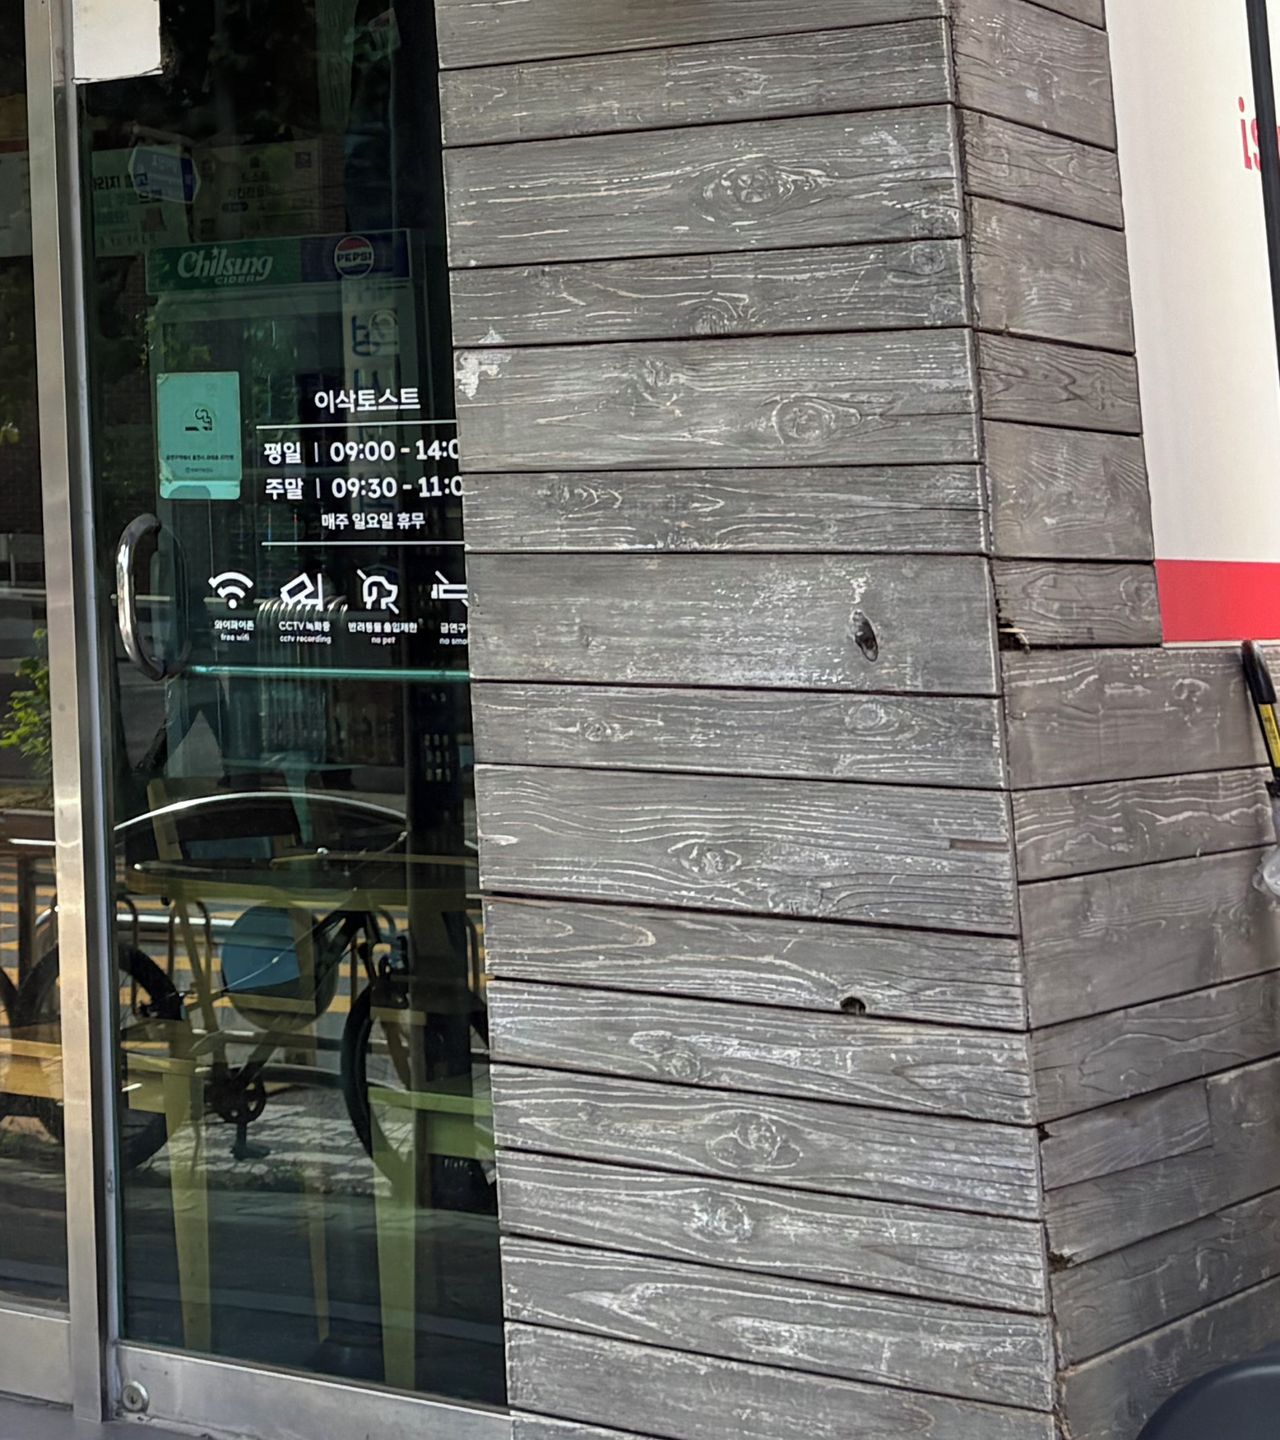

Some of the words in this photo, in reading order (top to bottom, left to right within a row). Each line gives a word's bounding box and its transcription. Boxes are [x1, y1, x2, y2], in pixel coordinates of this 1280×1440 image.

[177, 245, 273, 281] Chilsung
[314, 388, 421, 414] 이삭토스트
[264, 441, 302, 464] 평일
[329, 441, 396, 462] 09:00
[265, 477, 304, 500] 주말
[331, 477, 398, 498] 09:30
[418, 475, 464, 497] 11:0
[321, 513, 349, 530] 매주
[352, 512, 394, 530] 일요일
[397, 512, 426, 530] 휴무
[278, 621, 304, 632] CCTV
